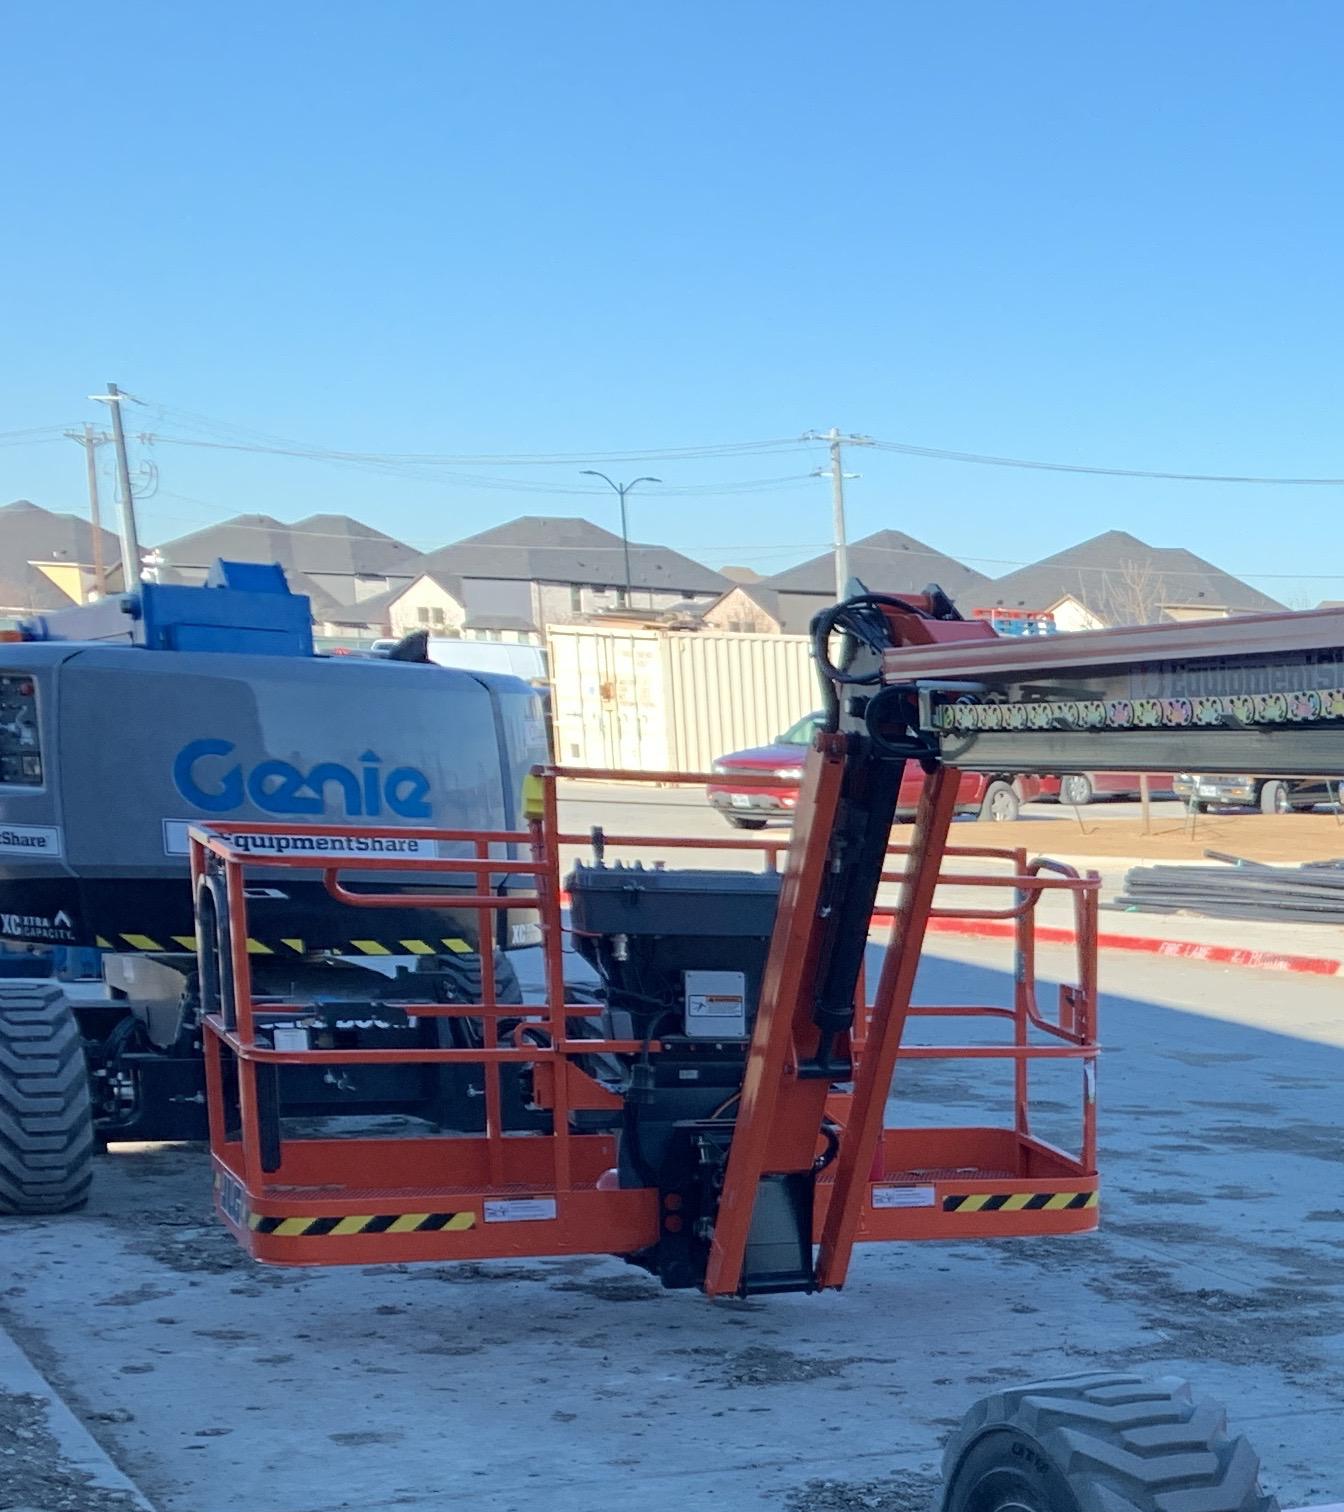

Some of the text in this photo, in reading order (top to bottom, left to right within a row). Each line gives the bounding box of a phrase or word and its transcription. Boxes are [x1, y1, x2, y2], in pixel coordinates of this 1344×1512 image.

[174, 738, 432, 818] Genie
[0, 830, 47, 848] Share
[223, 833, 420, 853] quipmentShare
[0, 913, 21, 936] XC
